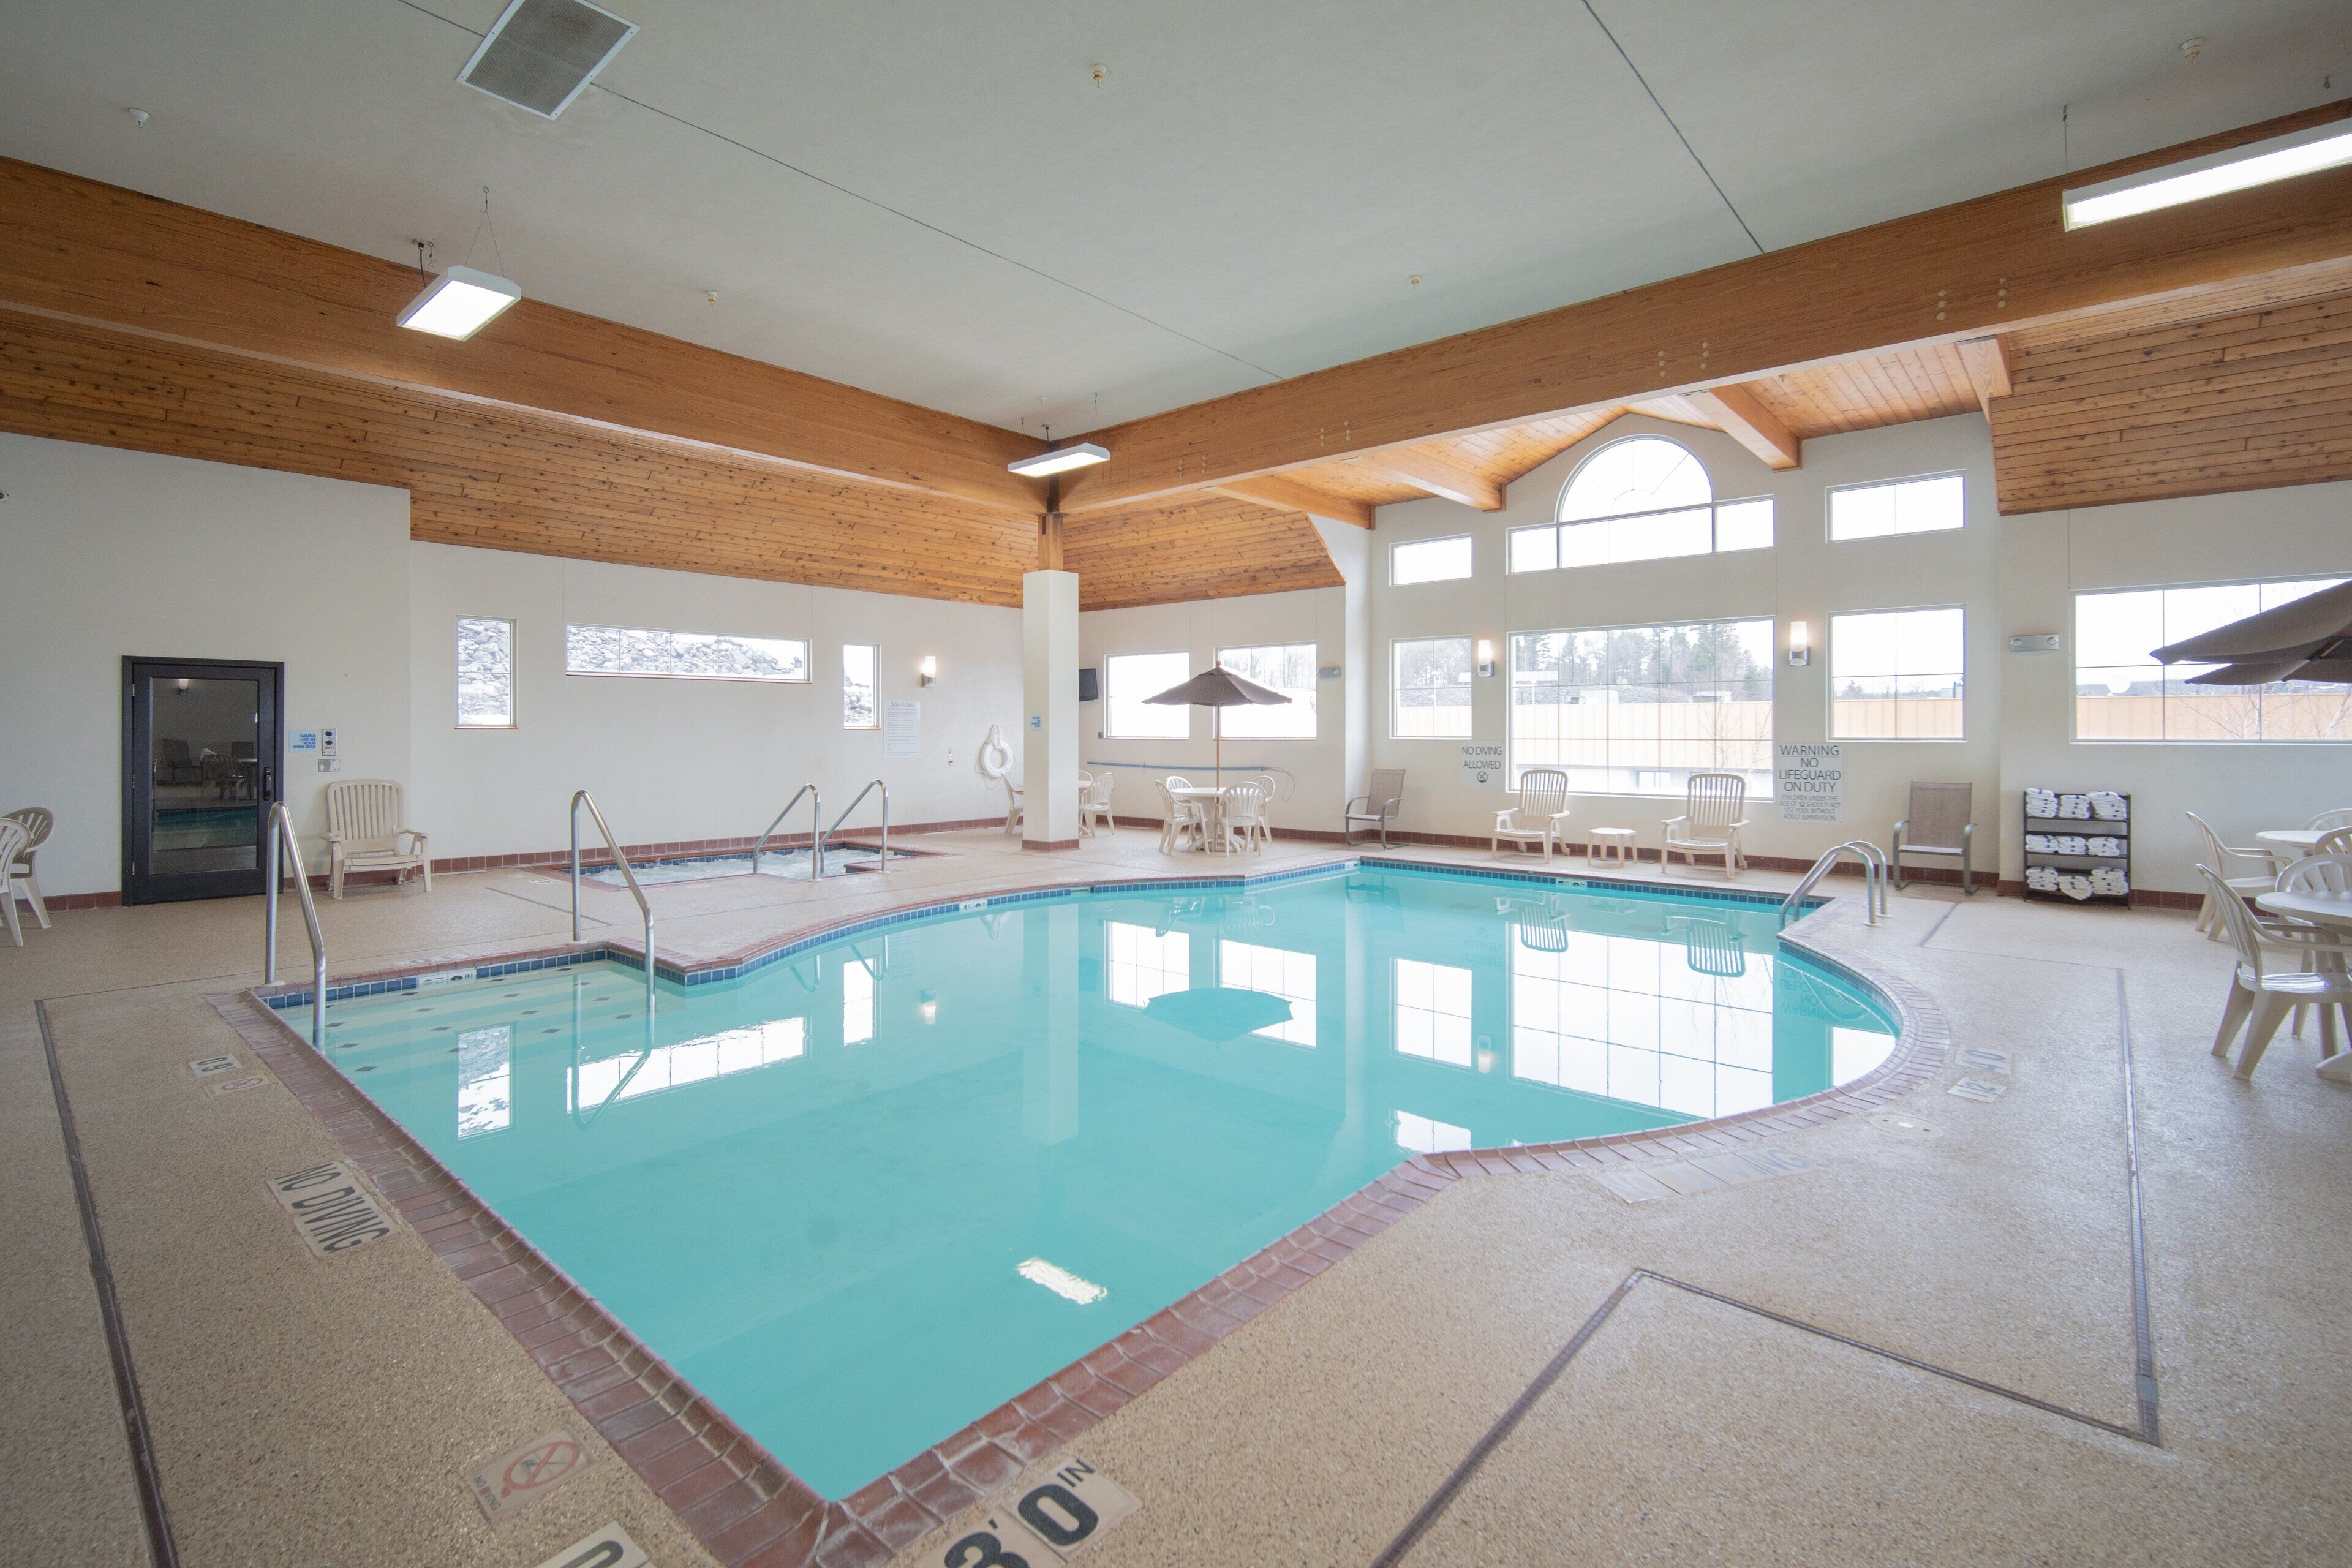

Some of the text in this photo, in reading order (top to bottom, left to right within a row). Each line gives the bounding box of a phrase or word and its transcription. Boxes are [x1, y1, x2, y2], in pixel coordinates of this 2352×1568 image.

[1462, 746, 1502, 755] NO DIVING
[1779, 745, 1839, 756] WARNING
[1463, 760, 1501, 769] ALLOWED
[1801, 757, 1819, 767] NO
[1779, 769, 1841, 780] LIFEGUARD
[1784, 782, 1837, 792] ON DUTY
[274, 1163, 390, 1254] NO DIVING
[1057, 1458, 1096, 1488] IN
